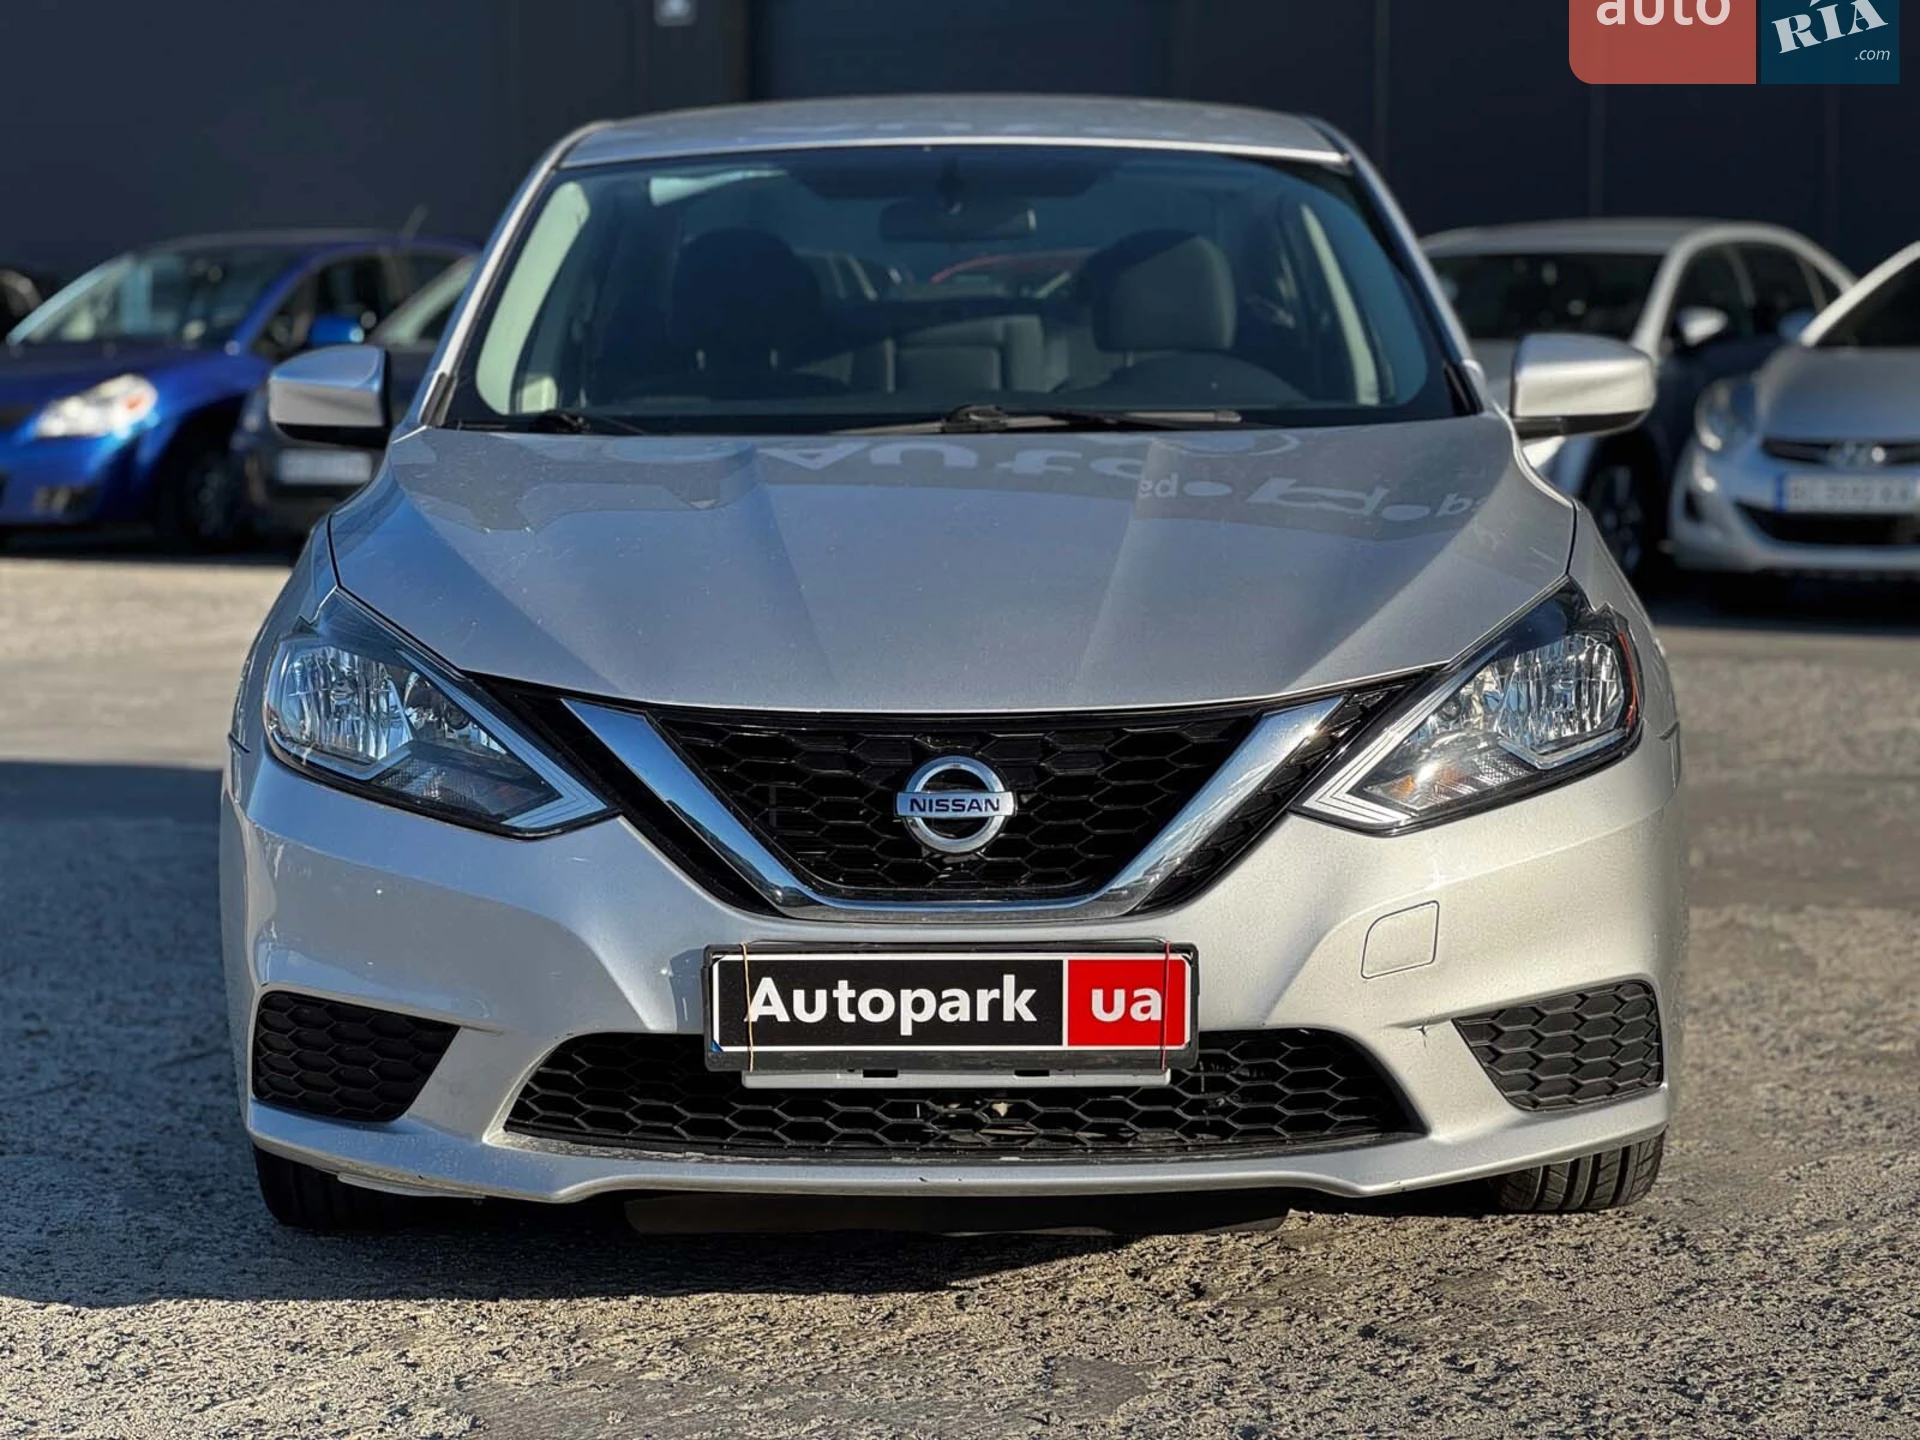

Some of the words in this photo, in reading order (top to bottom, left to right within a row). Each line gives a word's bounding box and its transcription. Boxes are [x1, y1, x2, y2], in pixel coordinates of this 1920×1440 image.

[910, 798, 1000, 812] NISSAN
[744, 974, 1037, 1036] Autopark
[1091, 988, 1163, 1022] ua
